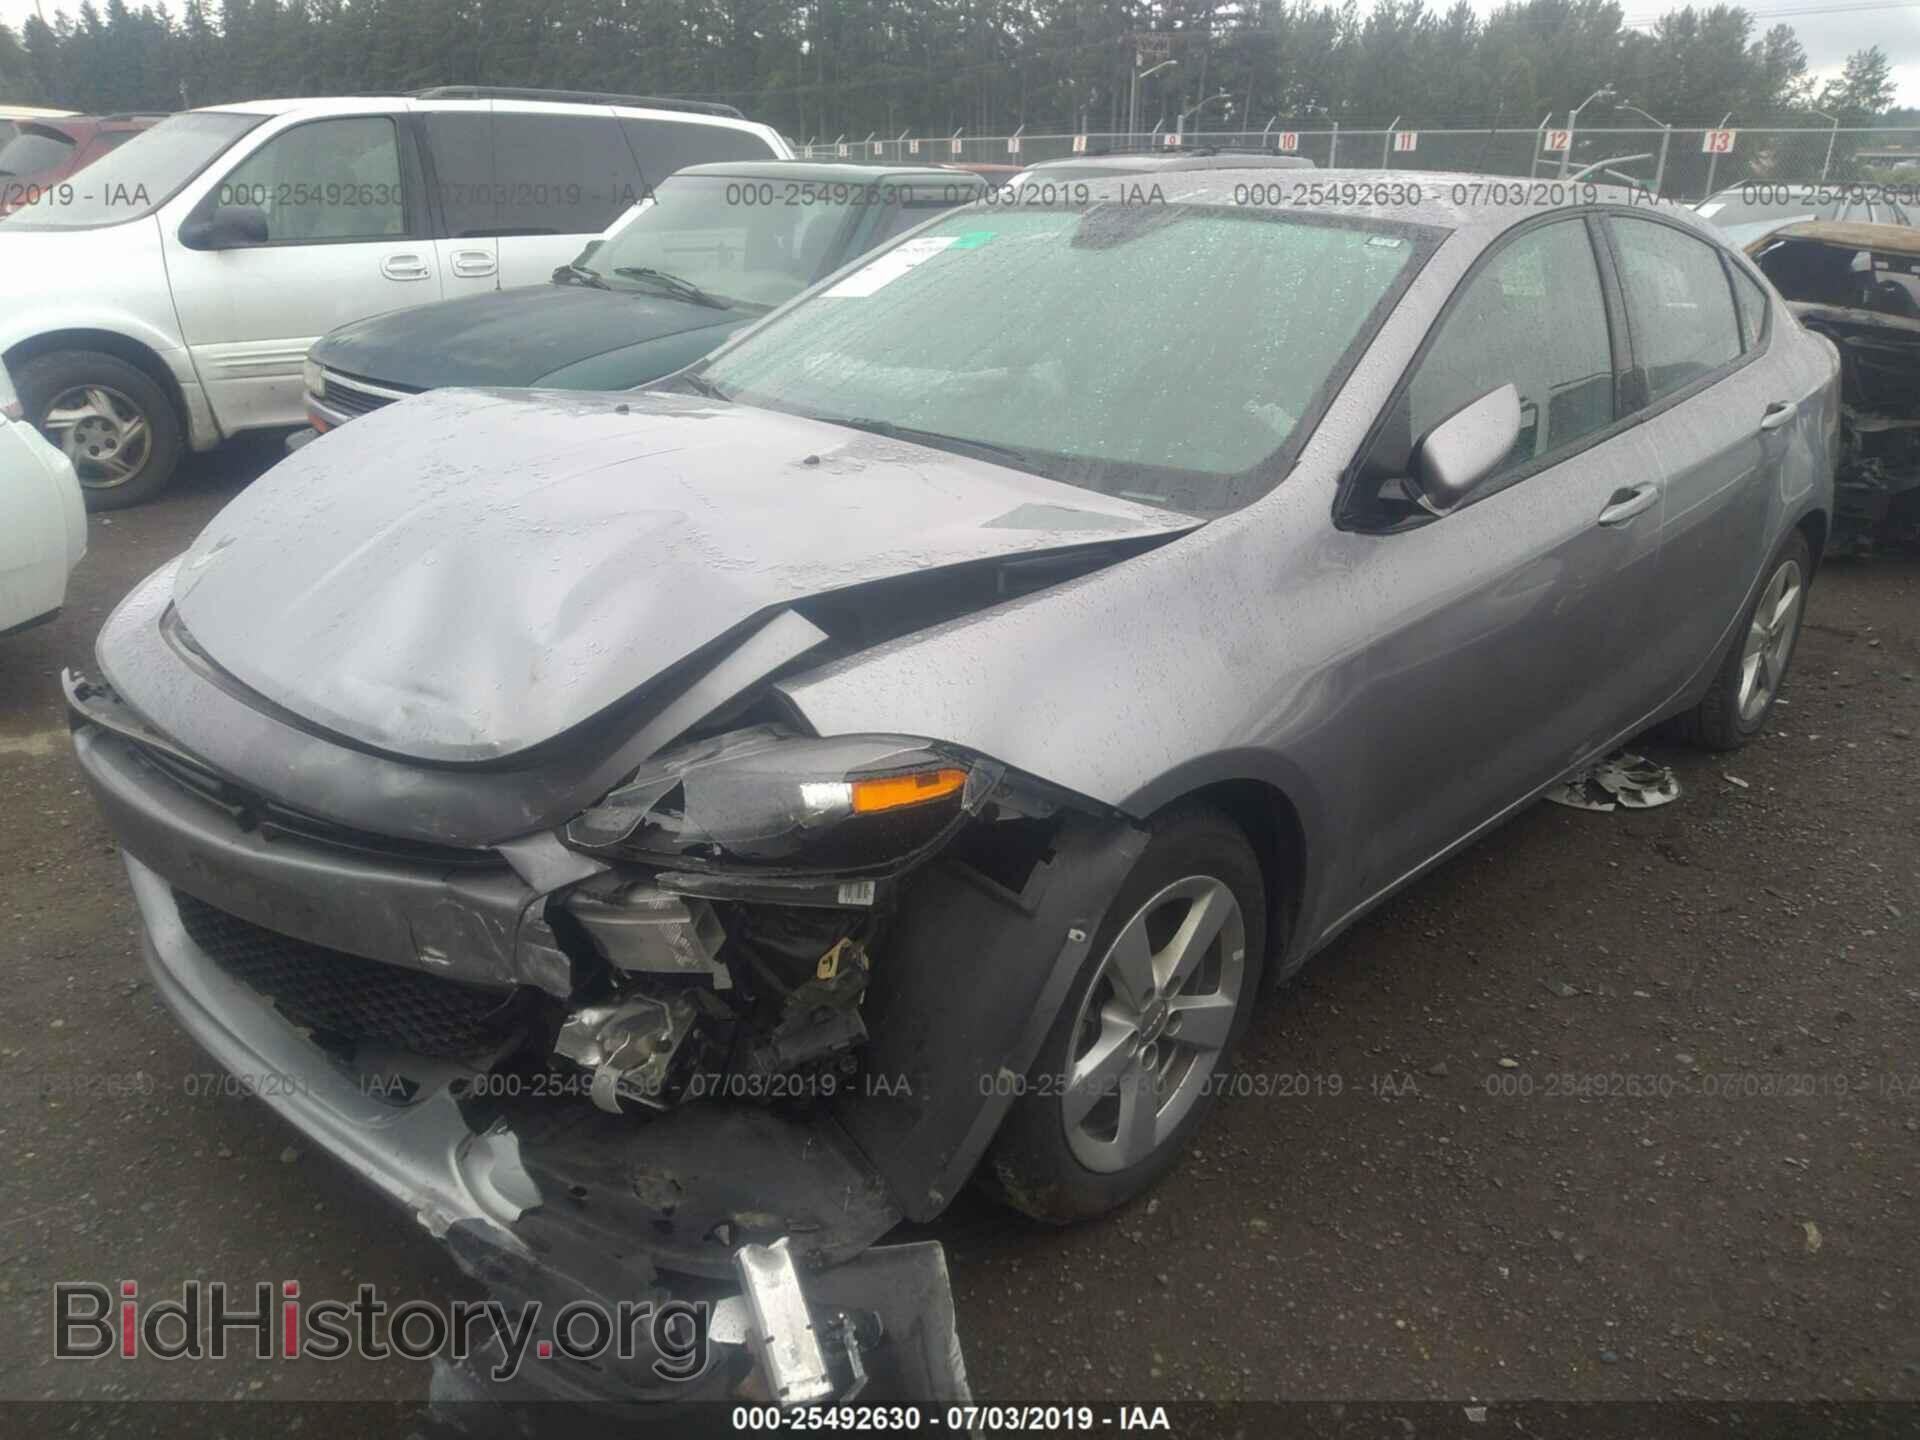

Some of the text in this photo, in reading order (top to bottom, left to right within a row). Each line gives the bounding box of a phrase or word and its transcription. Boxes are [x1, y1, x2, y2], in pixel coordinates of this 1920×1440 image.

[1282, 134, 1296, 149] 10
[1401, 134, 1413, 149] 11
[1550, 132, 1568, 148] 12
[1709, 133, 1730, 151] 13
